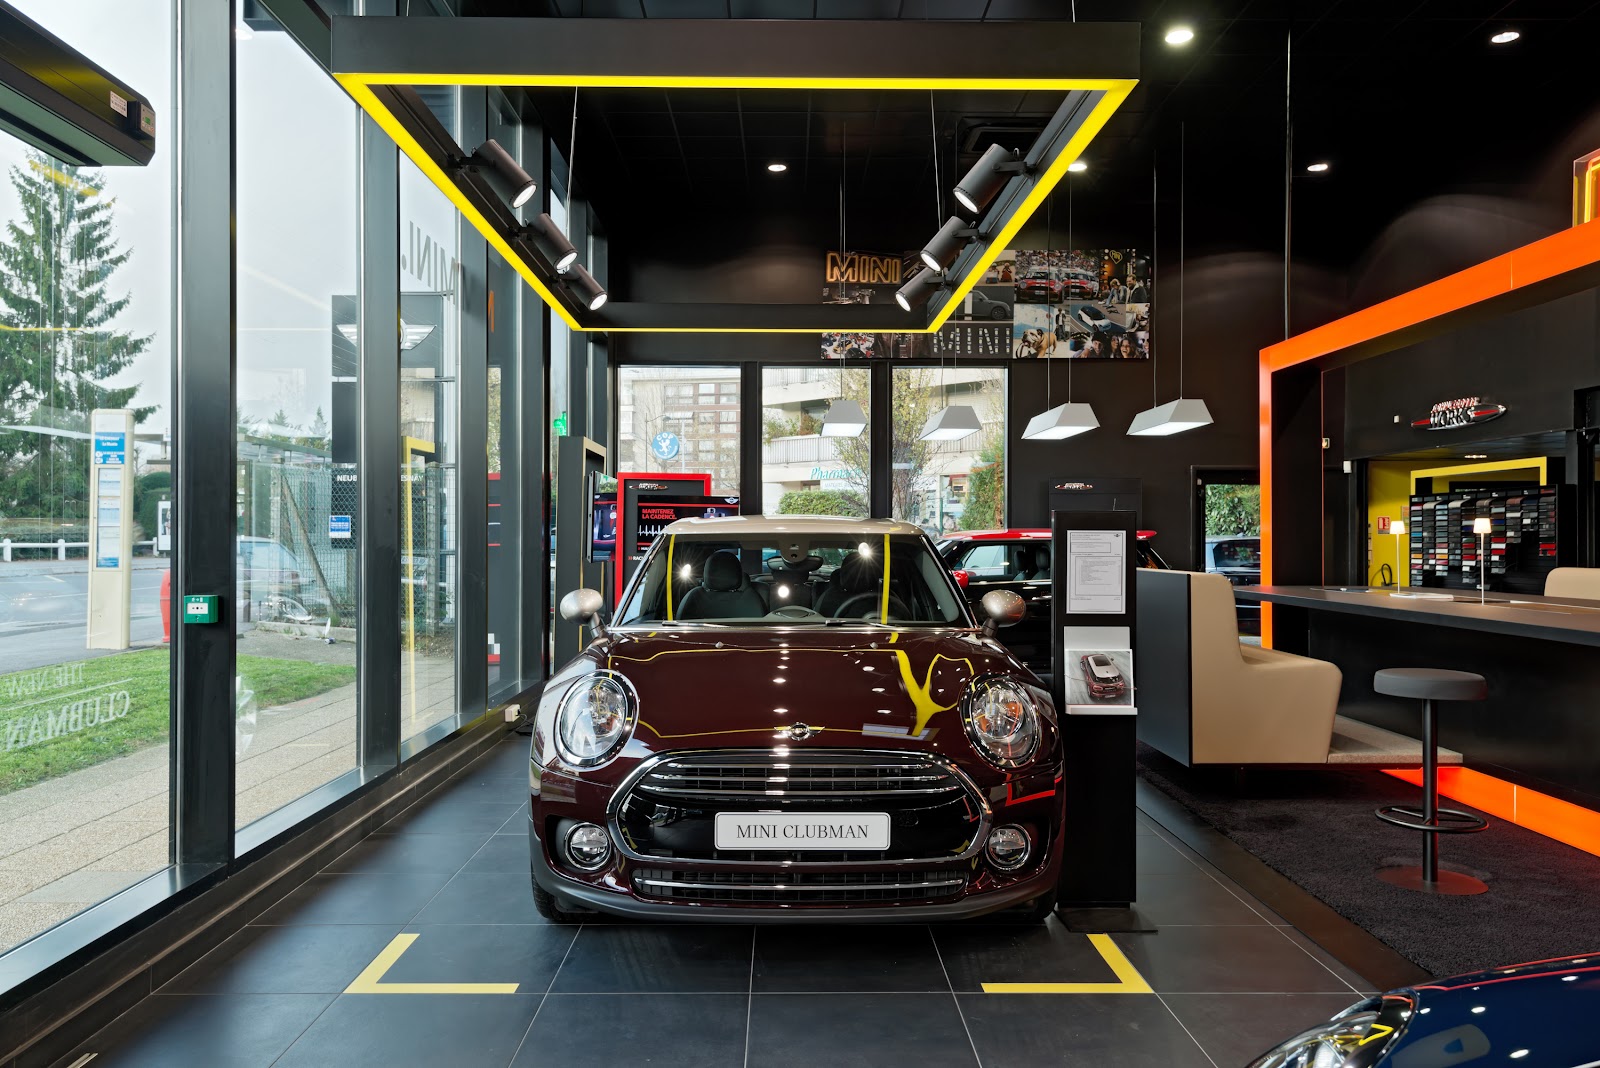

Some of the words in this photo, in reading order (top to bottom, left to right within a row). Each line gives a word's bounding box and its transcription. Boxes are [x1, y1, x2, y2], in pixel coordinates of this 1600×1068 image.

[826, 252, 901, 284] MINI
[1430, 408, 1476, 428] WORKS
[656, 432, 674, 441] COP
[737, 824, 778, 839] MINI
[783, 824, 869, 839] CLUBMAN
